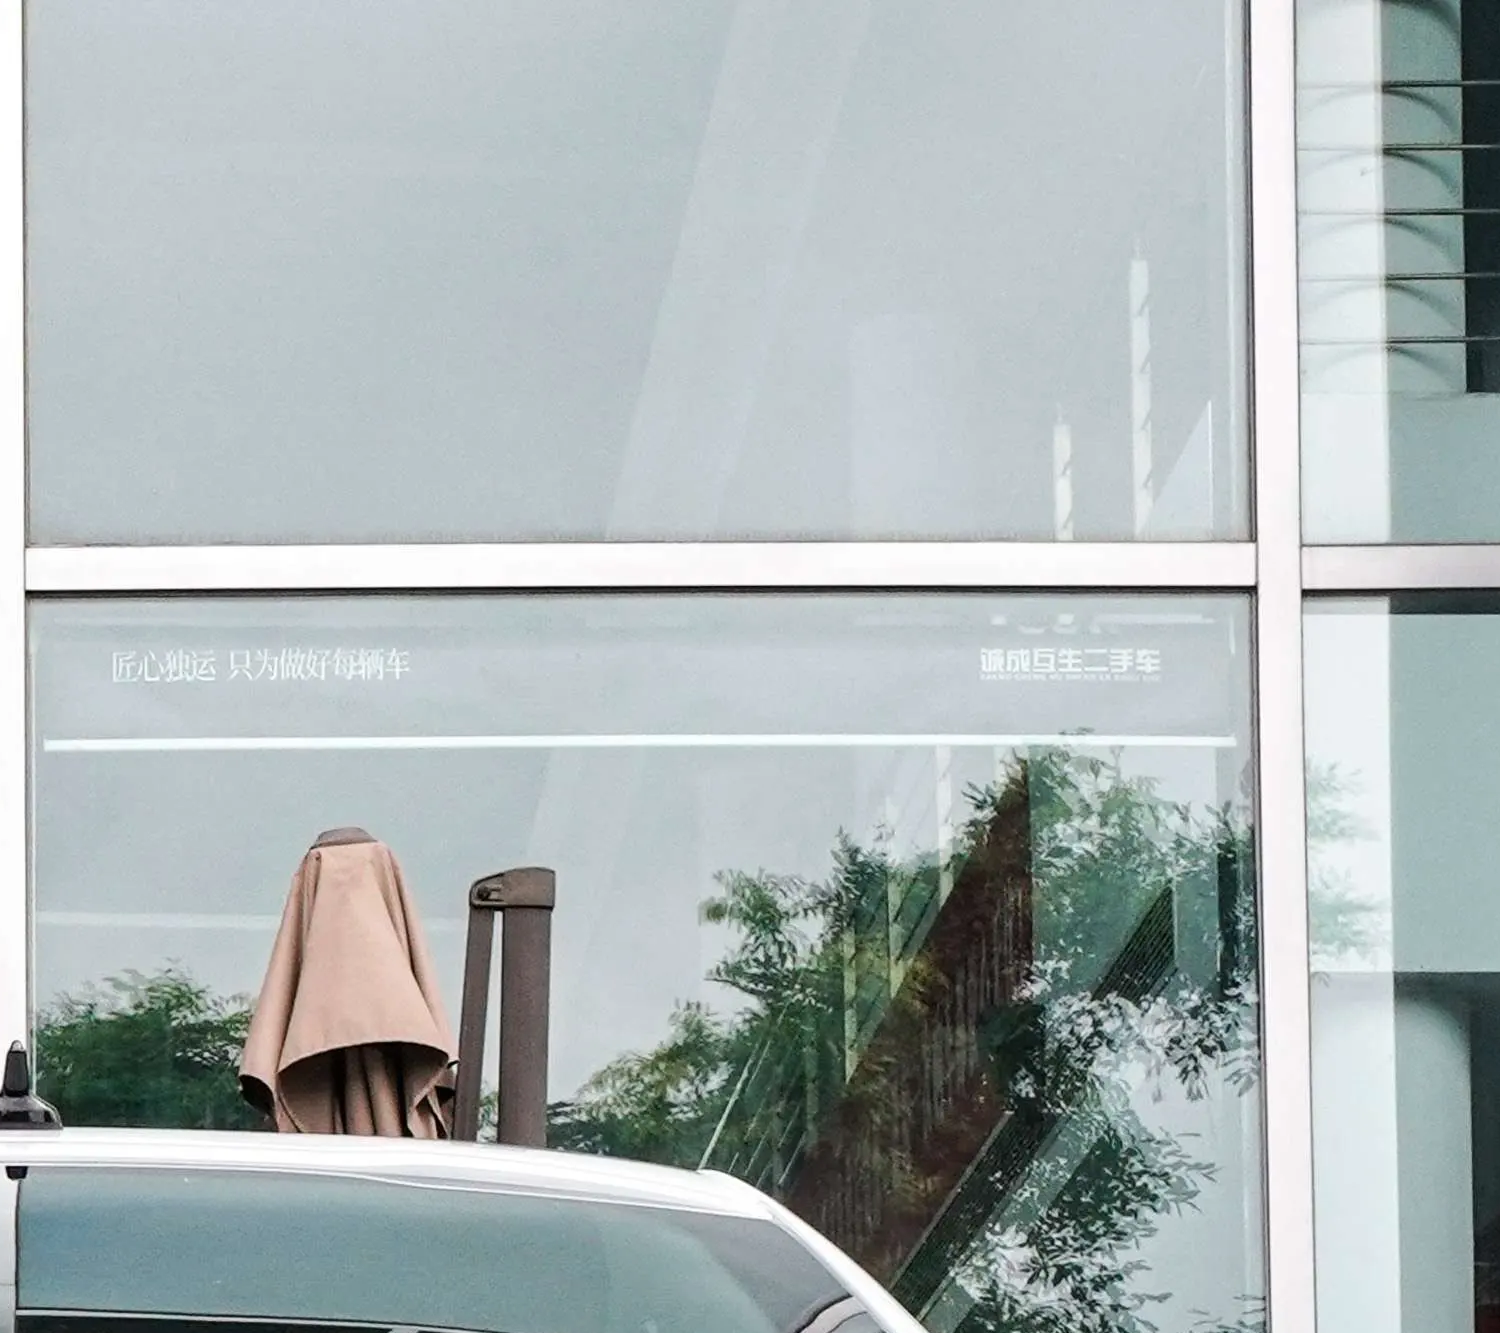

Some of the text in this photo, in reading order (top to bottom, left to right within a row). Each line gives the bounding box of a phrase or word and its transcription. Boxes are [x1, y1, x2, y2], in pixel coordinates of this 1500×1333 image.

[111, 647, 411, 683] 匠心独运 只为做好每辆车
[979, 647, 1162, 674] 诚成互生二手车
